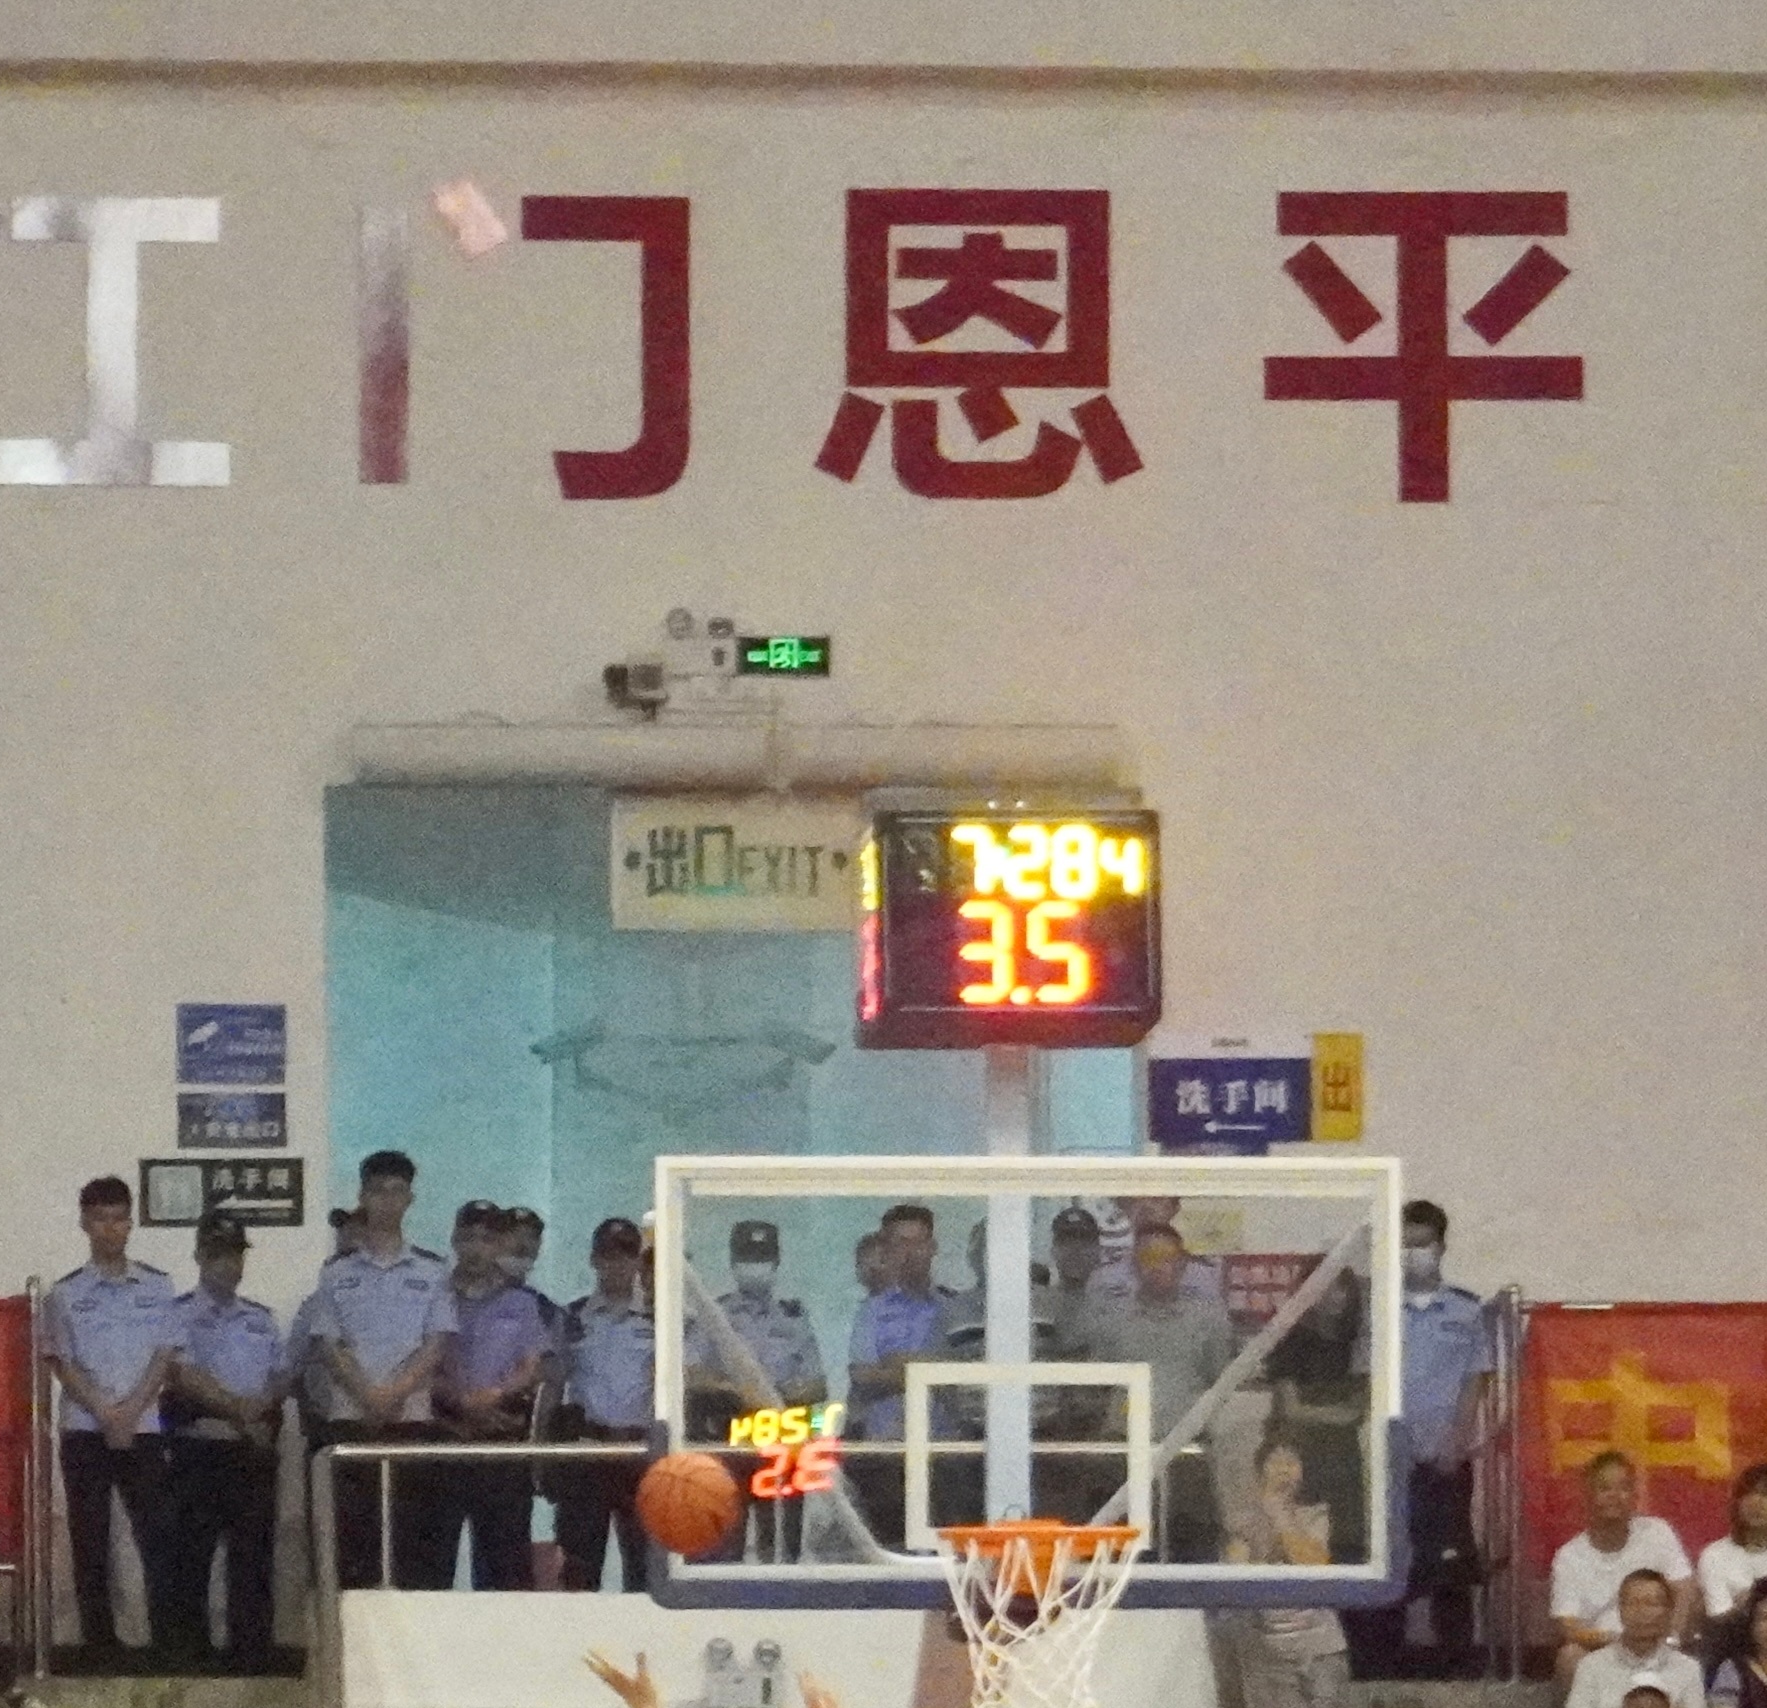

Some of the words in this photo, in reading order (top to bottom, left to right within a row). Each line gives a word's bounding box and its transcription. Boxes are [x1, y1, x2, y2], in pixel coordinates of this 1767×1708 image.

[958, 900, 1091, 1006] 3.5
[1175, 1079, 1288, 1115] 洗手间
